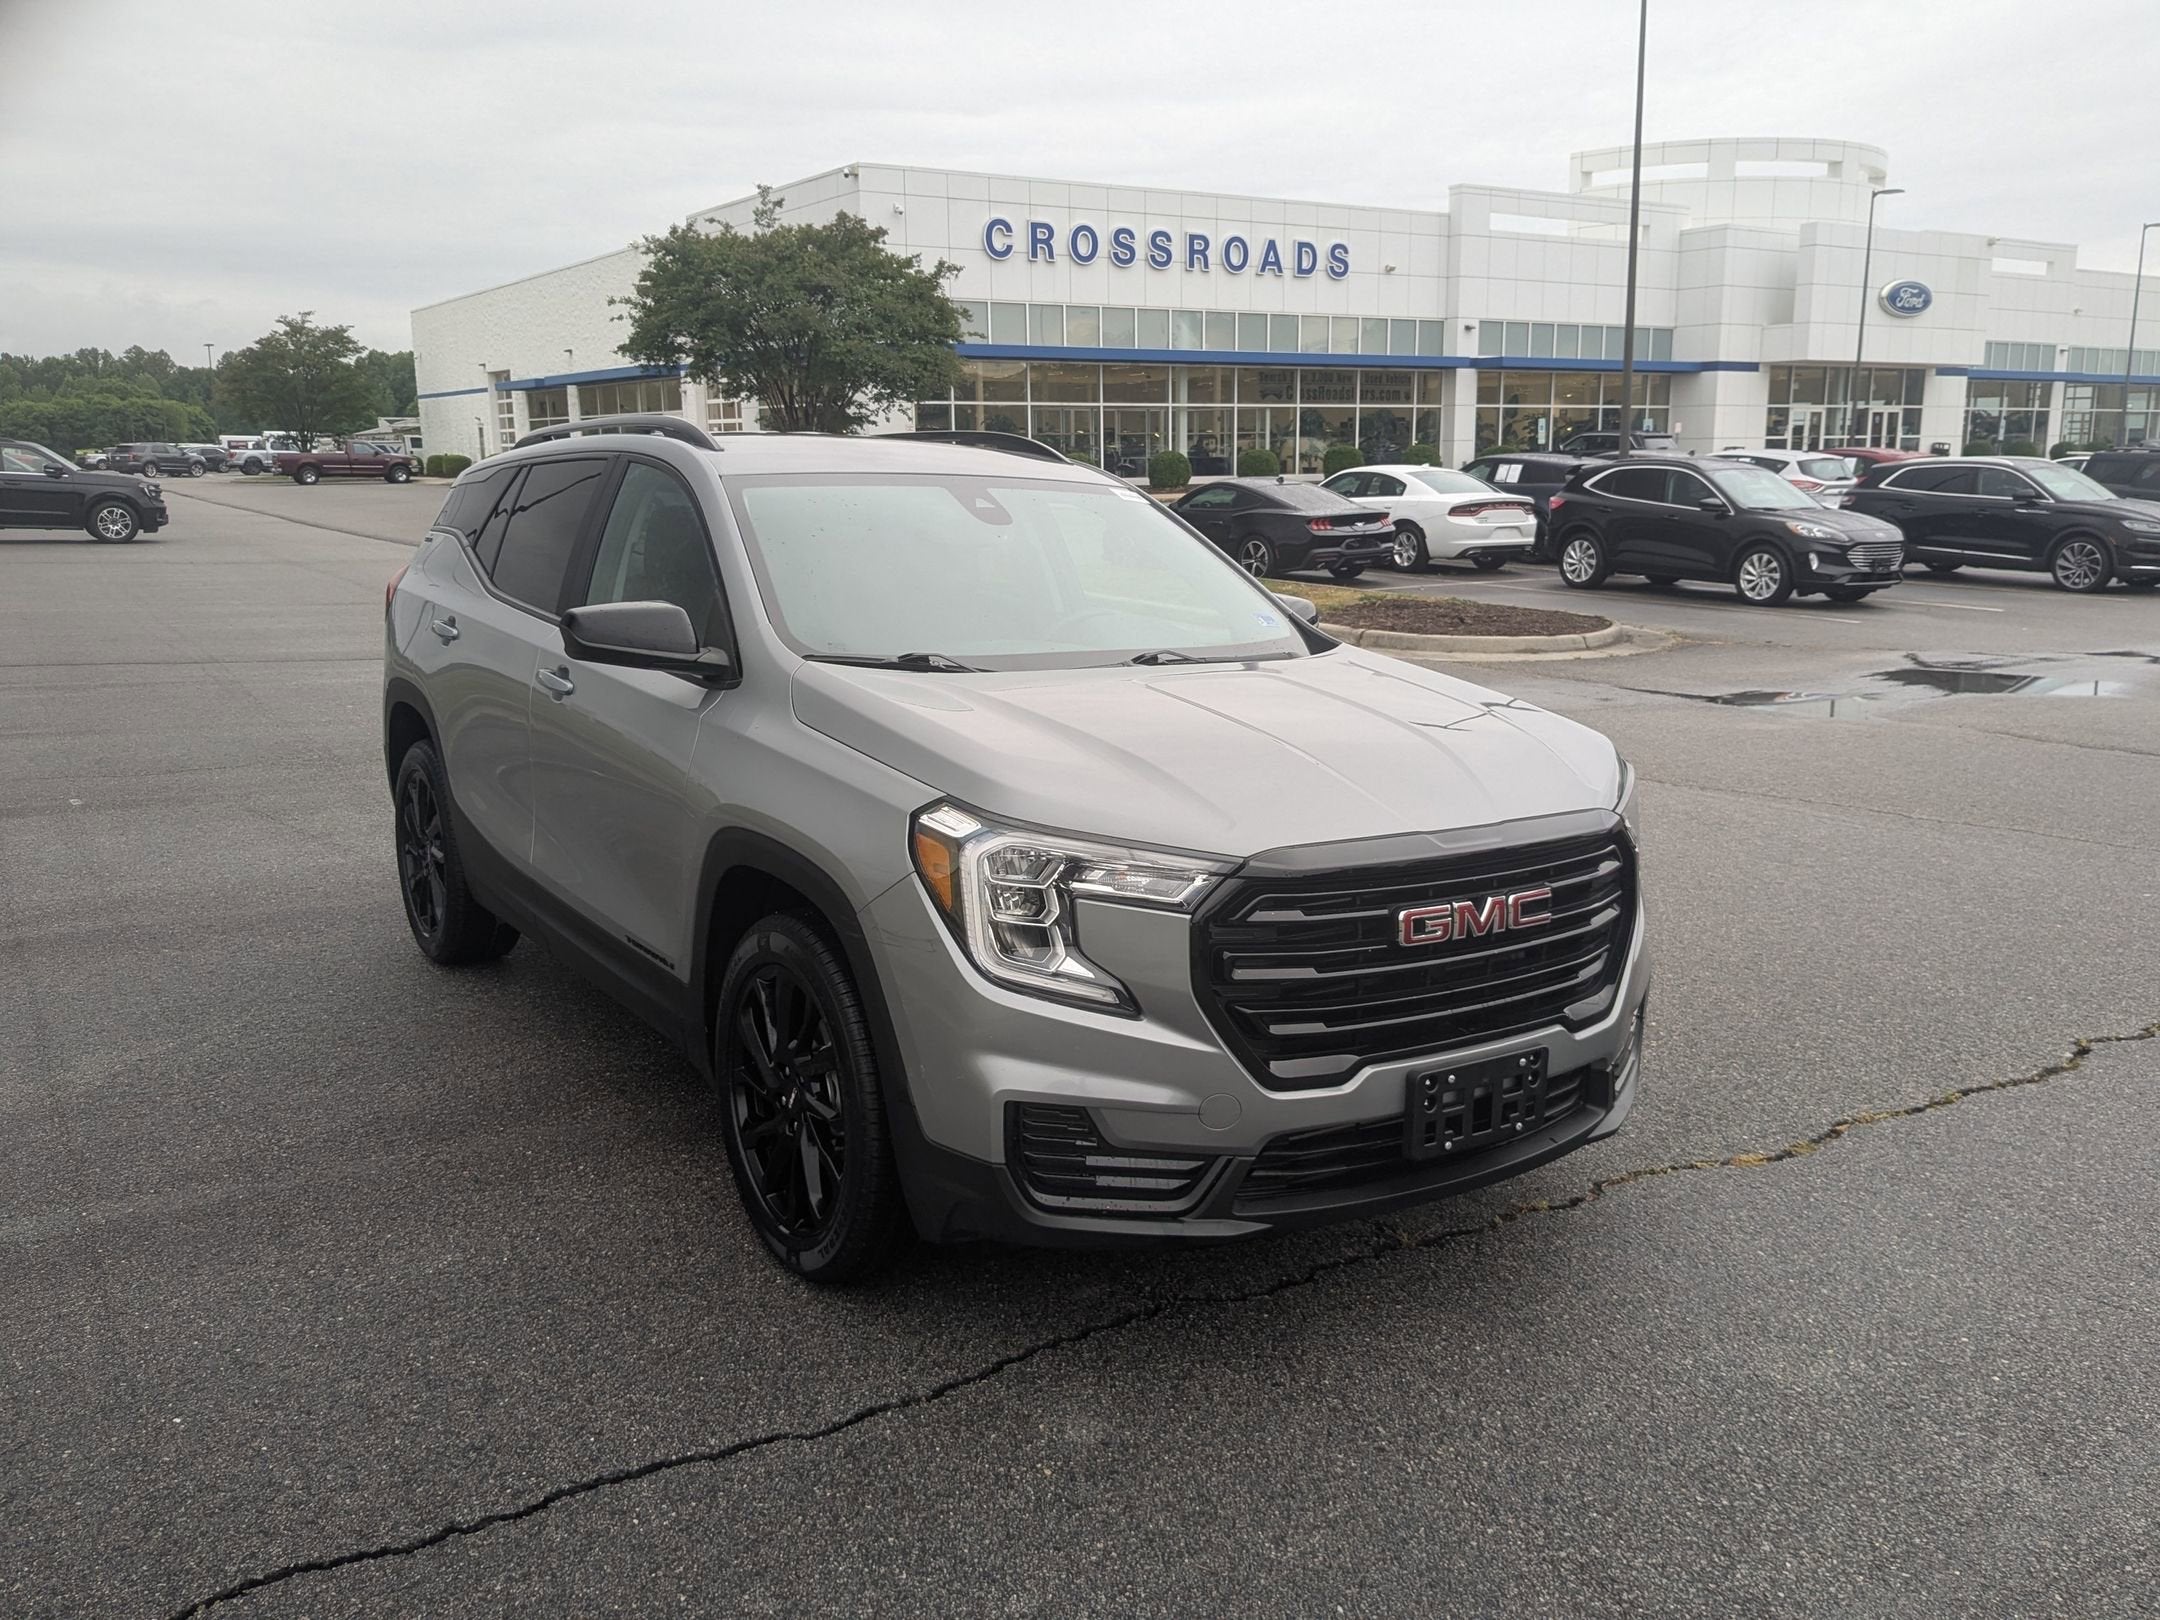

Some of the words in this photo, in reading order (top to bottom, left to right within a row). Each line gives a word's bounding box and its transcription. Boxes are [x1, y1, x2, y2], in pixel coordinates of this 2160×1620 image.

[983, 217, 1351, 280] CROSSROADS
[1896, 287, 1925, 308] Ford
[1397, 886, 1553, 948] GMC
